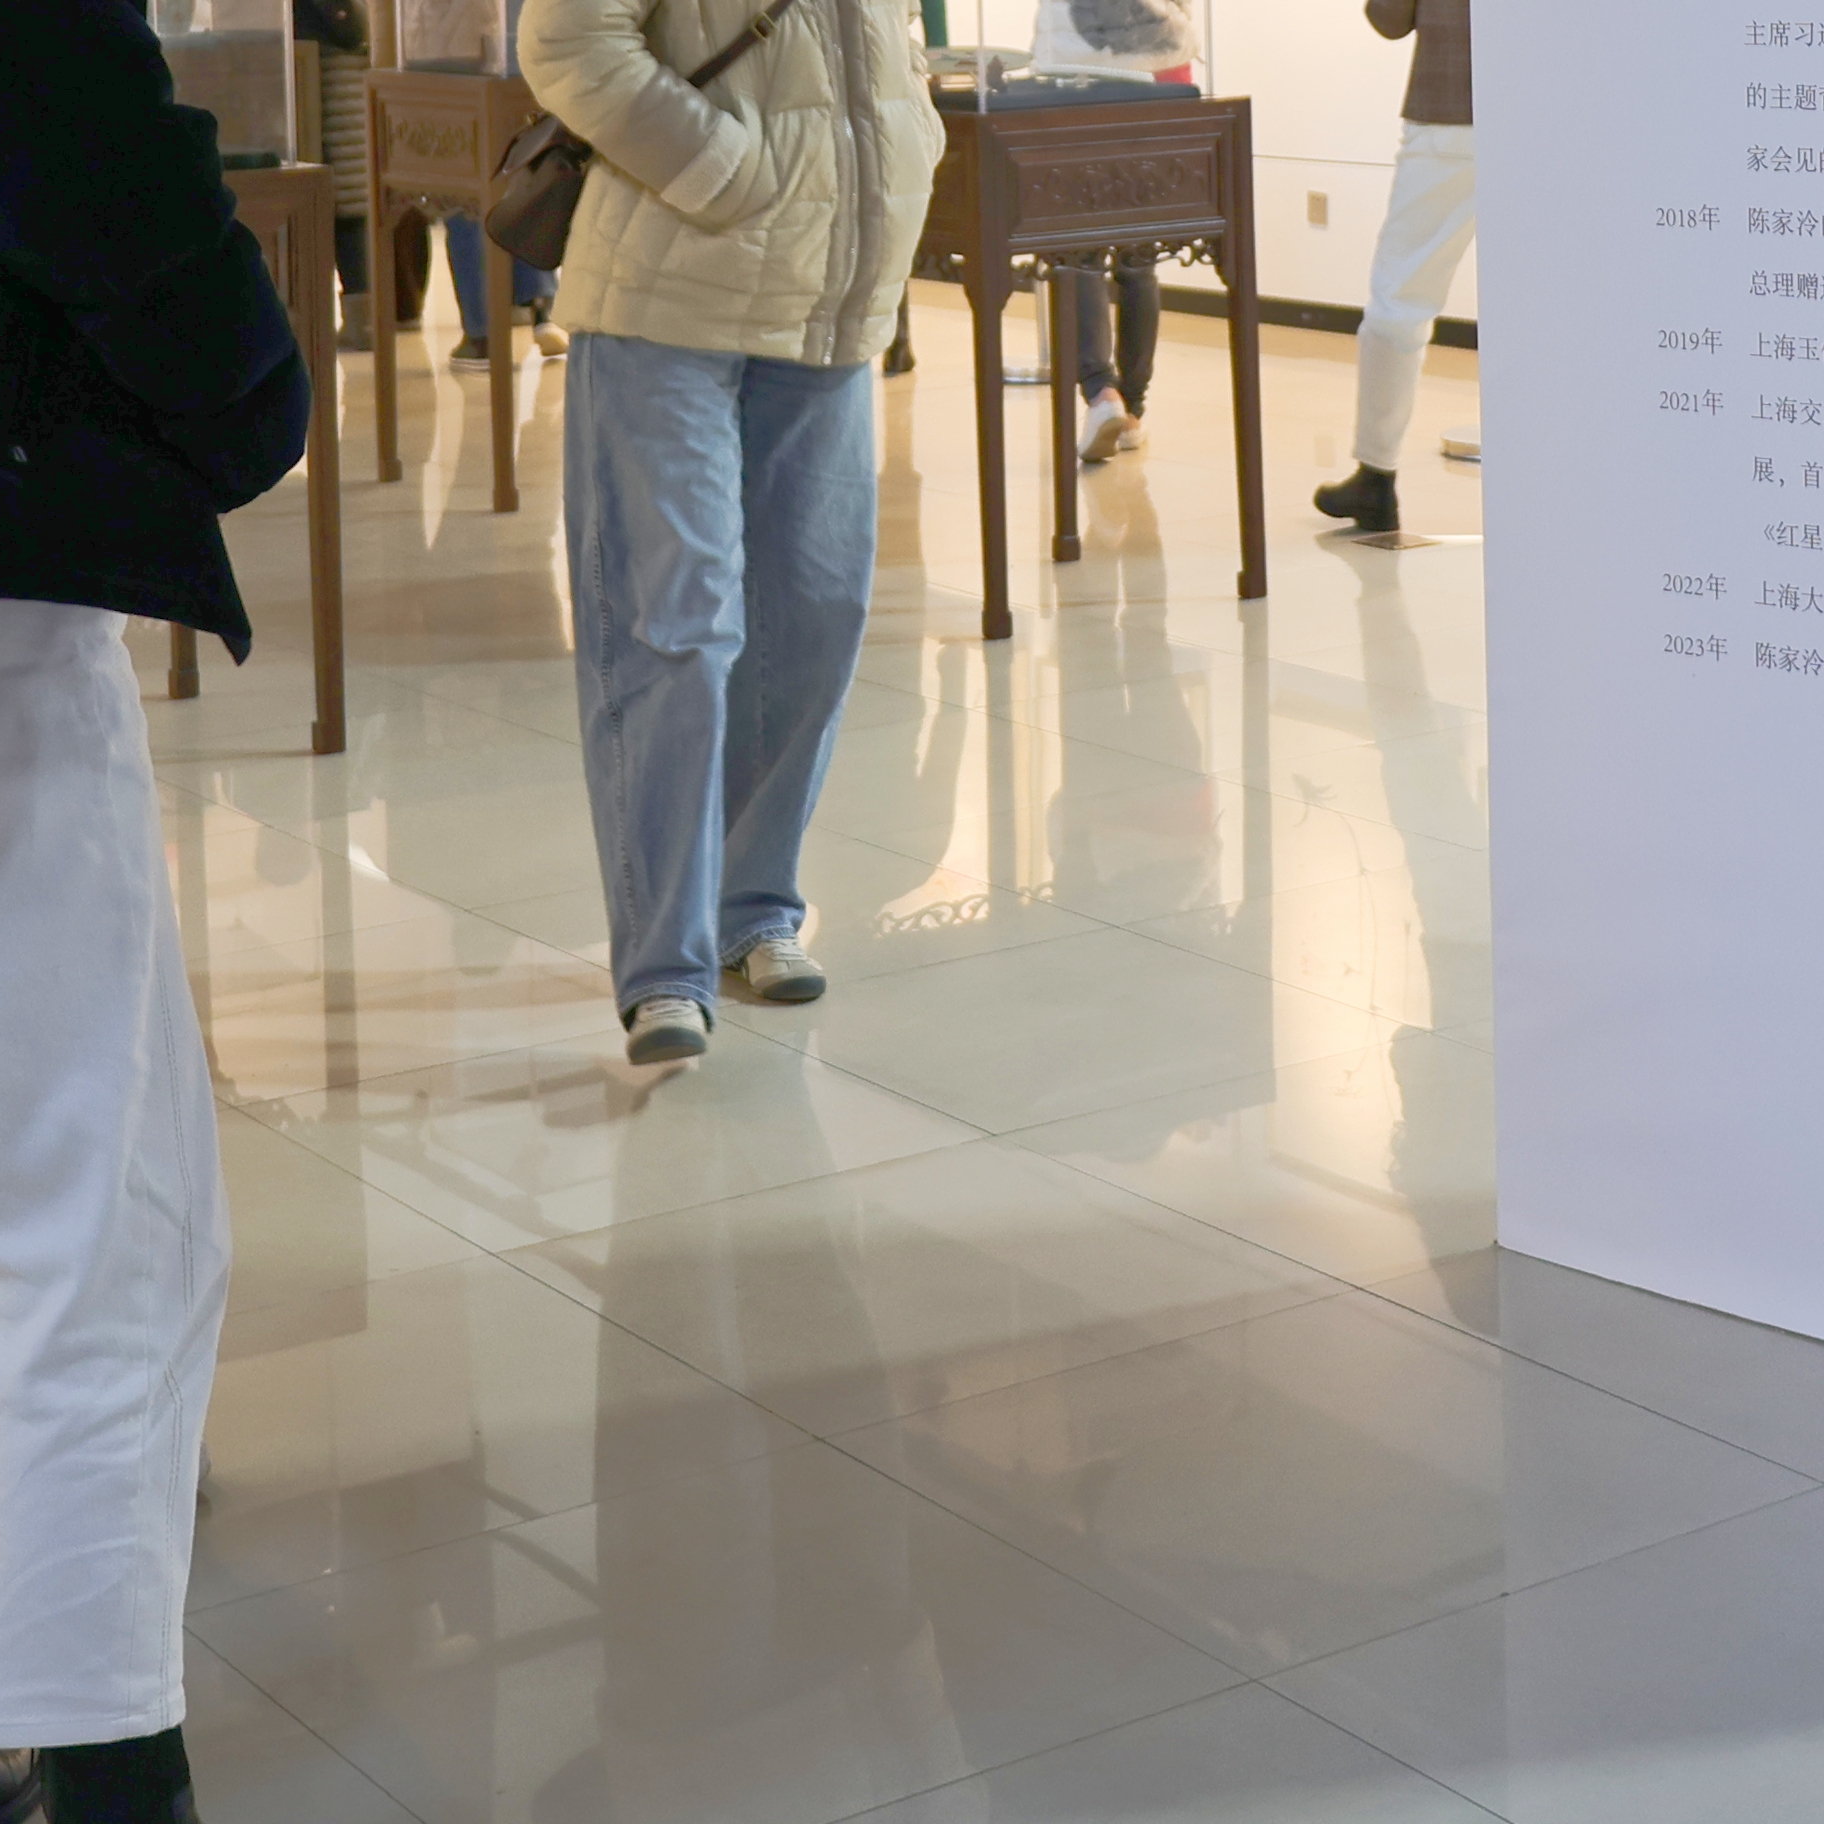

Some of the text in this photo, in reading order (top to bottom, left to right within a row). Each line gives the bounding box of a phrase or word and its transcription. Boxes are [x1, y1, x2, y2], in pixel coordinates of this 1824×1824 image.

[1655, 203, 1721, 232] 2018年
[1657, 326, 1724, 355] 2019年
[1659, 388, 1724, 417] 2021年
[1662, 572, 1728, 601] 2022年
[1663, 633, 1729, 662] 2023年
